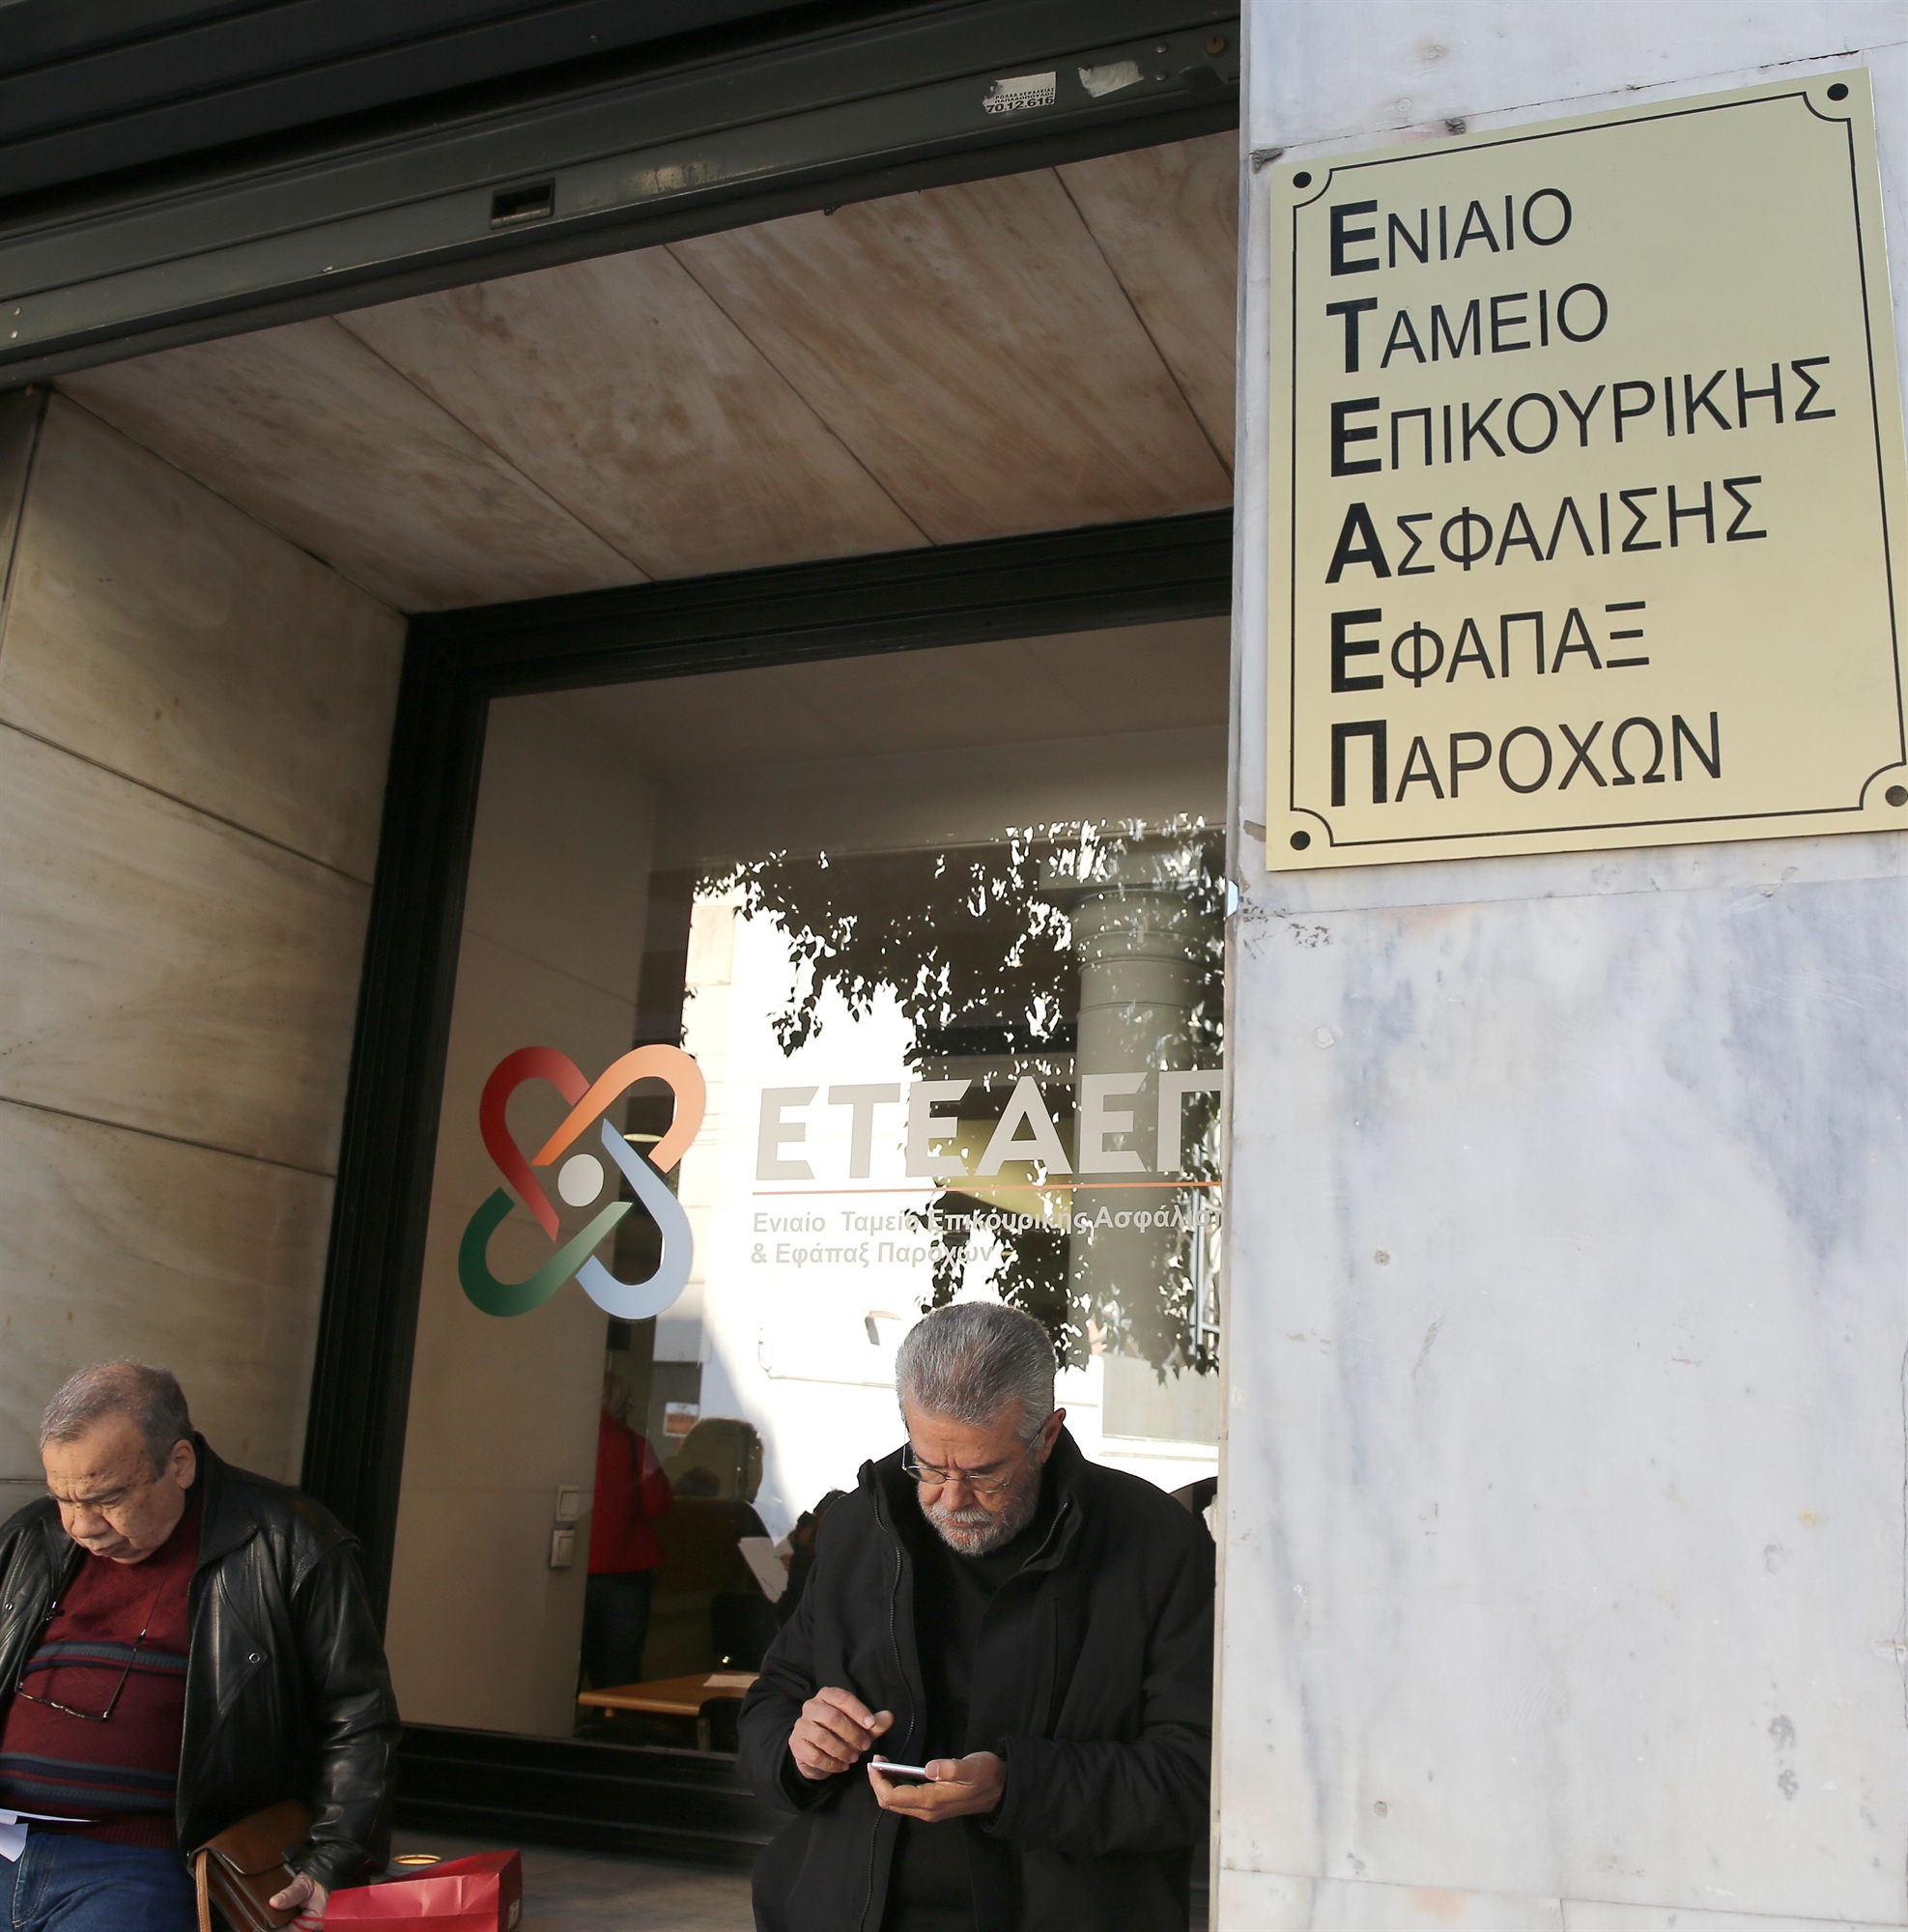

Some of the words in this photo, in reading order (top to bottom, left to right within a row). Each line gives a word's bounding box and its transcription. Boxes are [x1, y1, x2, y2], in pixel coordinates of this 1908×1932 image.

[986, 96, 1054, 113] 70.12.616
[1329, 187, 1573, 276] ΕΝΙΑΙΟ
[1325, 282, 1608, 374] ΤΑΜΕΙΟ
[1330, 355, 1837, 477] ΕΠΙΚΟΥΡΙΚΗΣ
[1324, 475, 1767, 583] ΑΣΦΑΛΙΣΗΣ
[1330, 600, 1650, 694] ΕΦΑΠΑΞ
[1330, 711, 1722, 807] ΠΑΡΟΧΩΝ
[750, 1242, 769, 1264] &
[775, 1242, 869, 1268] Εφάπαξ
[877, 1240, 994, 1268] Παροχών
[753, 1211, 826, 1233] Ενιαίο
[840, 1209, 919, 1233] Ταμείο
